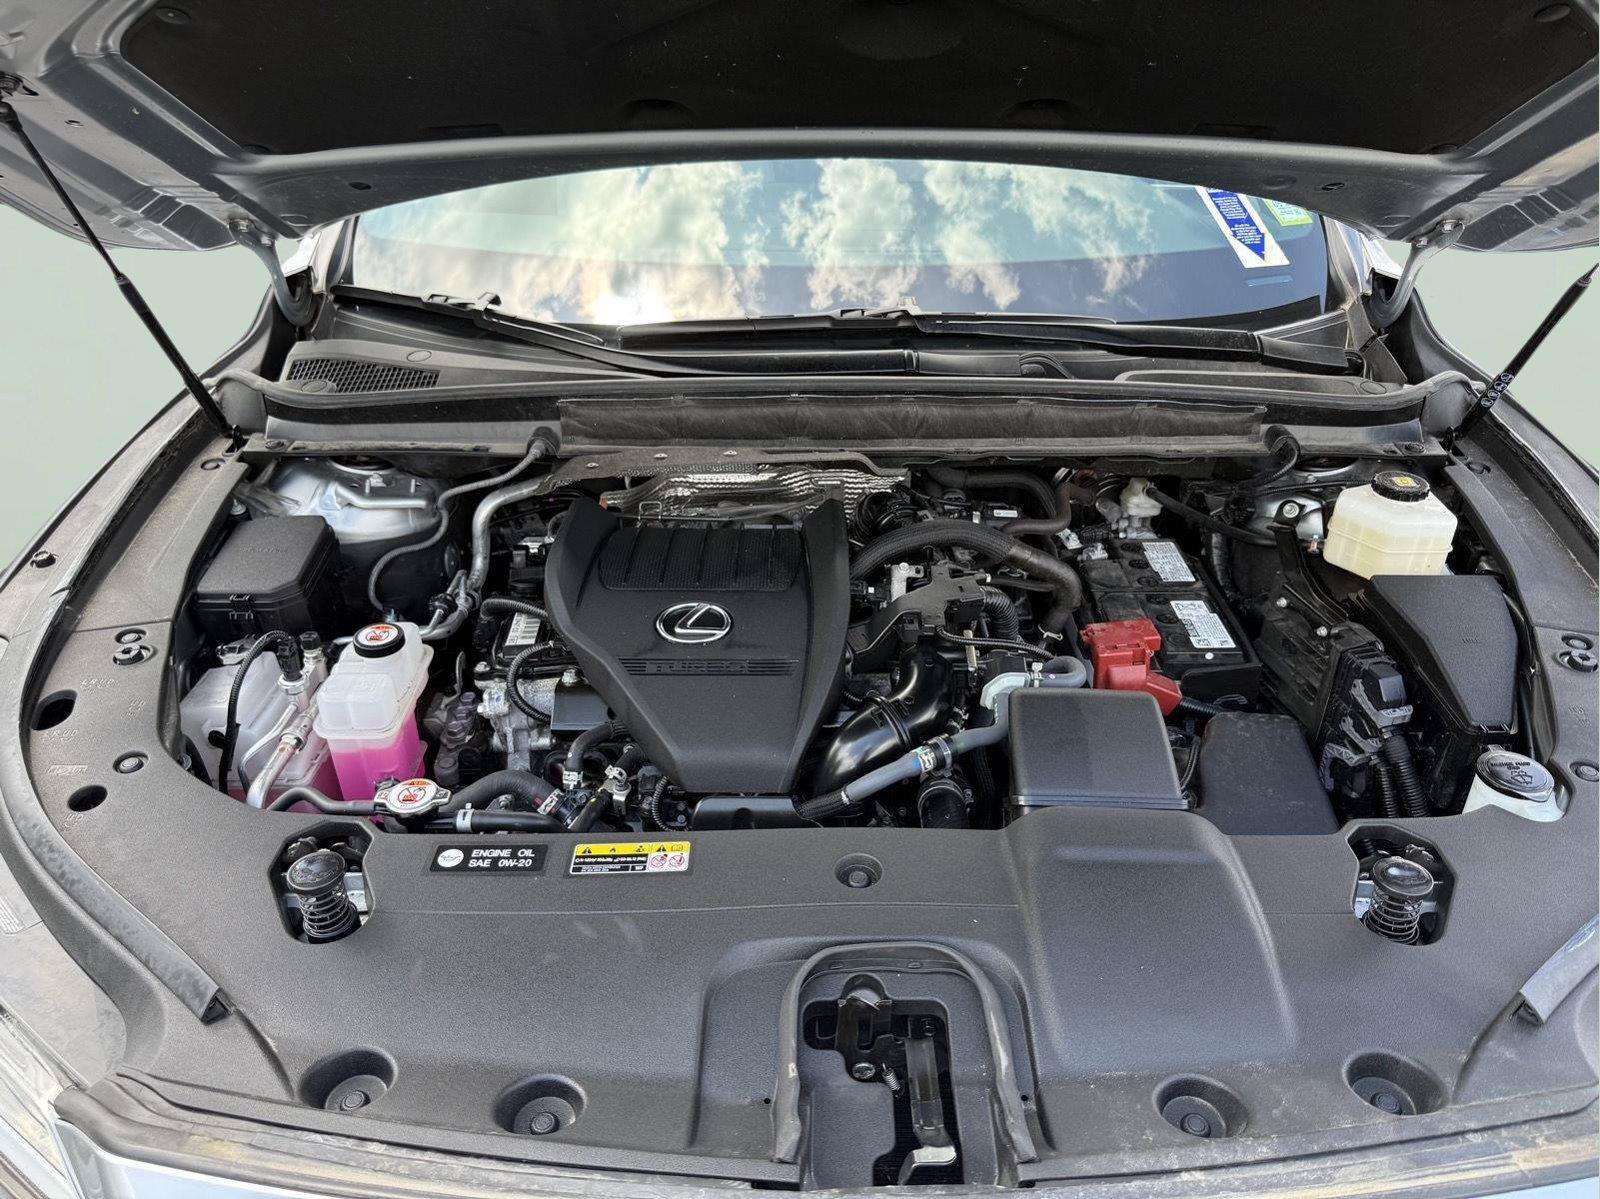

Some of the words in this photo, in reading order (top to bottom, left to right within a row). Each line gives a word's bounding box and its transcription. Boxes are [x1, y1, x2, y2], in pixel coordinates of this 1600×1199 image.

[471, 849, 512, 857] ENGINE
[517, 848, 536, 857] OIL
[468, 858, 492, 868] SAE
[498, 858, 533, 867] 0W-20
